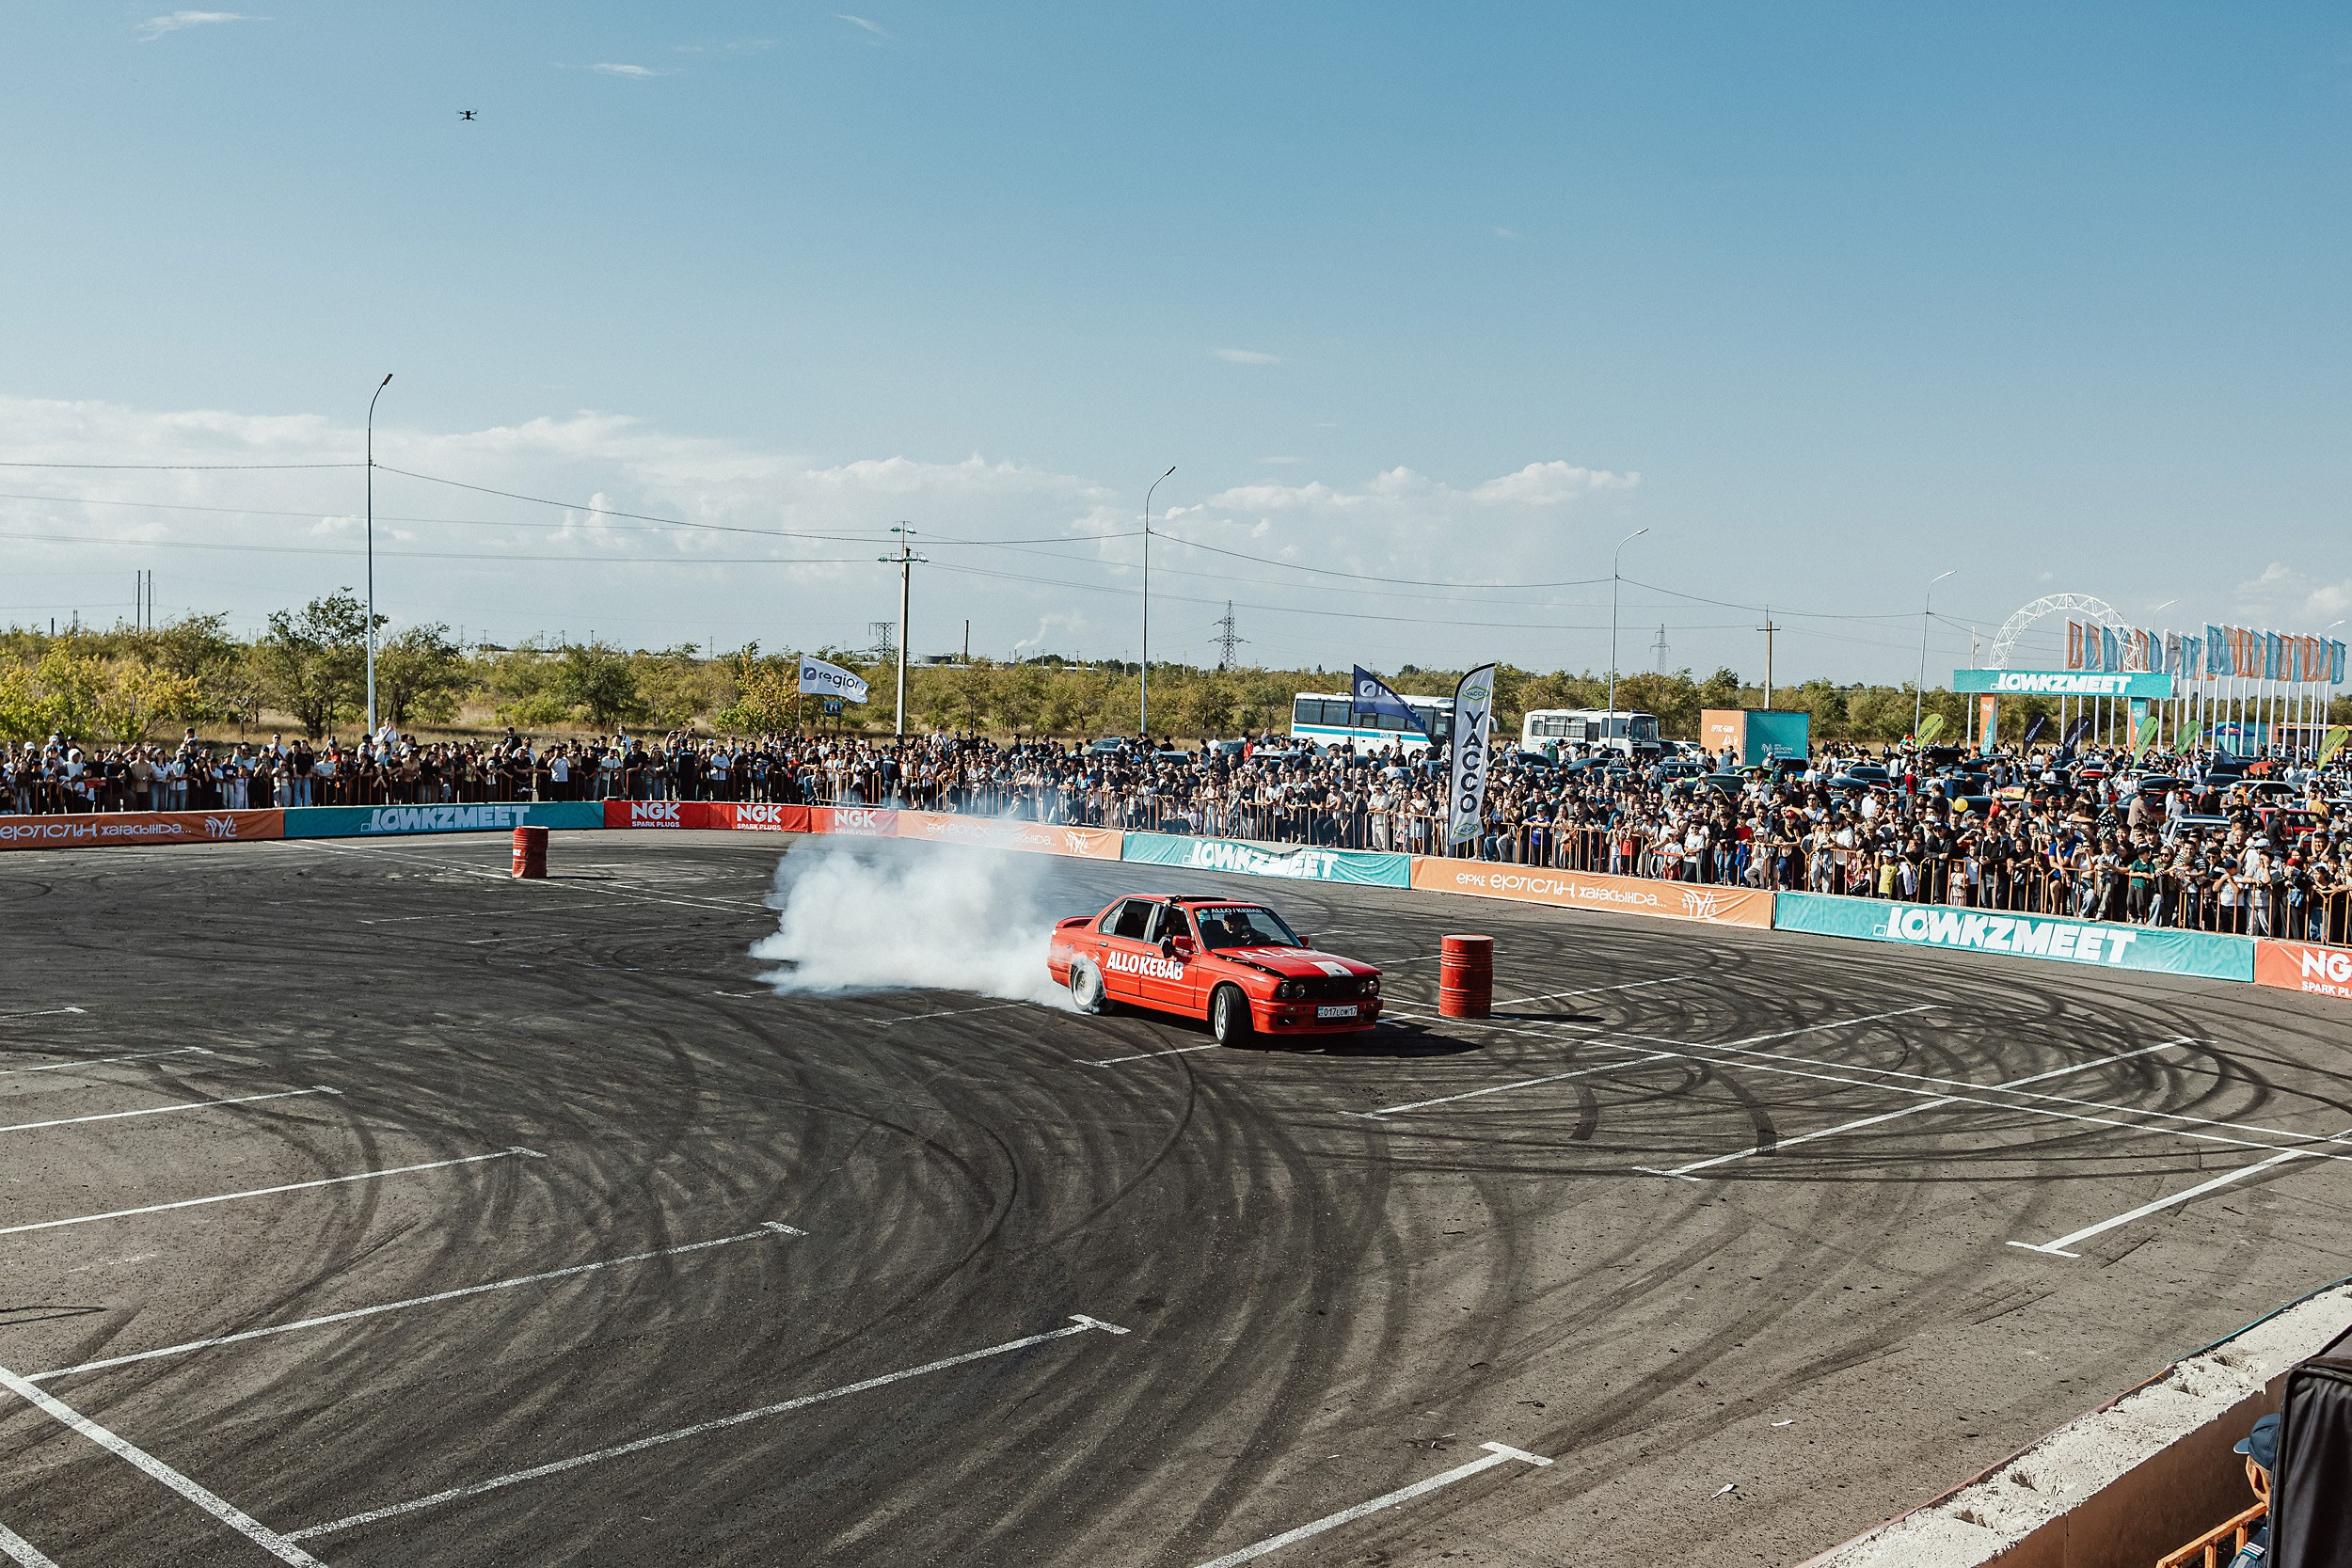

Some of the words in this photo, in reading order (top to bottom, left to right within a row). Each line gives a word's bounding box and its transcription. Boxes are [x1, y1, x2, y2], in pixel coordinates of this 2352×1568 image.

[1460, 711, 1485, 814] YACCO
[631, 802, 680, 820] NGK
[737, 804, 782, 824] NGK
[834, 809, 877, 828] NGK
[1886, 907, 2137, 964] LOWKZMEET
[2301, 980, 2336, 995] SPARK
